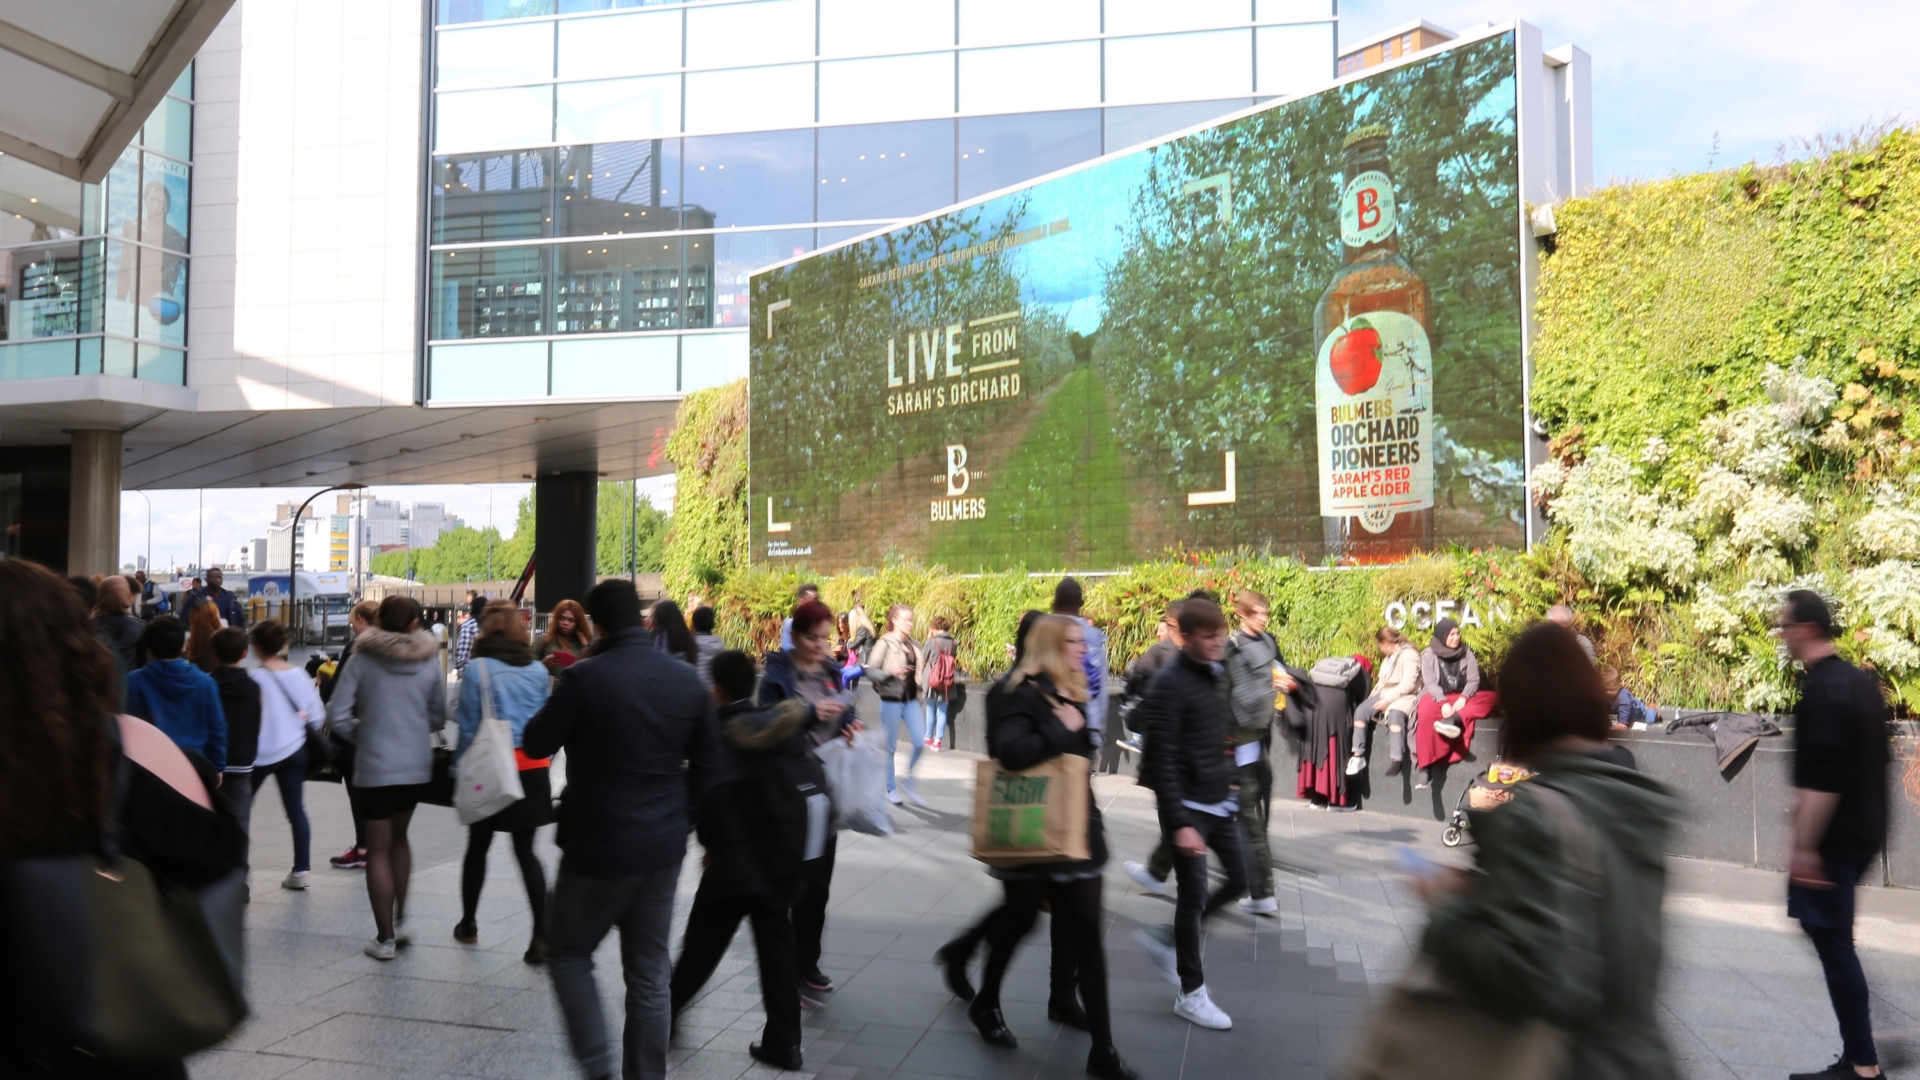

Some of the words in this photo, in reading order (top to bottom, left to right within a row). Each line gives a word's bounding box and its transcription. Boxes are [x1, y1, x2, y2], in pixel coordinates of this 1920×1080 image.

[888, 266, 901, 282] RED
[902, 260, 926, 278] APPLE
[887, 323, 963, 389] LIVE
[972, 325, 1017, 358] FROM
[887, 385, 946, 416] SARAH'S
[950, 373, 1021, 406] ORCHARD
[1331, 398, 1394, 424] BULMERS
[1331, 415, 1420, 447] ORCHARD
[1331, 440, 1421, 471] PIONEERS
[1332, 469, 1382, 485] SARAH'S
[1385, 466, 1411, 481] RED
[1333, 484, 1368, 499] APPLE
[1370, 481, 1411, 497] CIDER
[930, 497, 986, 522] BULMERS
[1384, 599, 1512, 630] OCEAN
